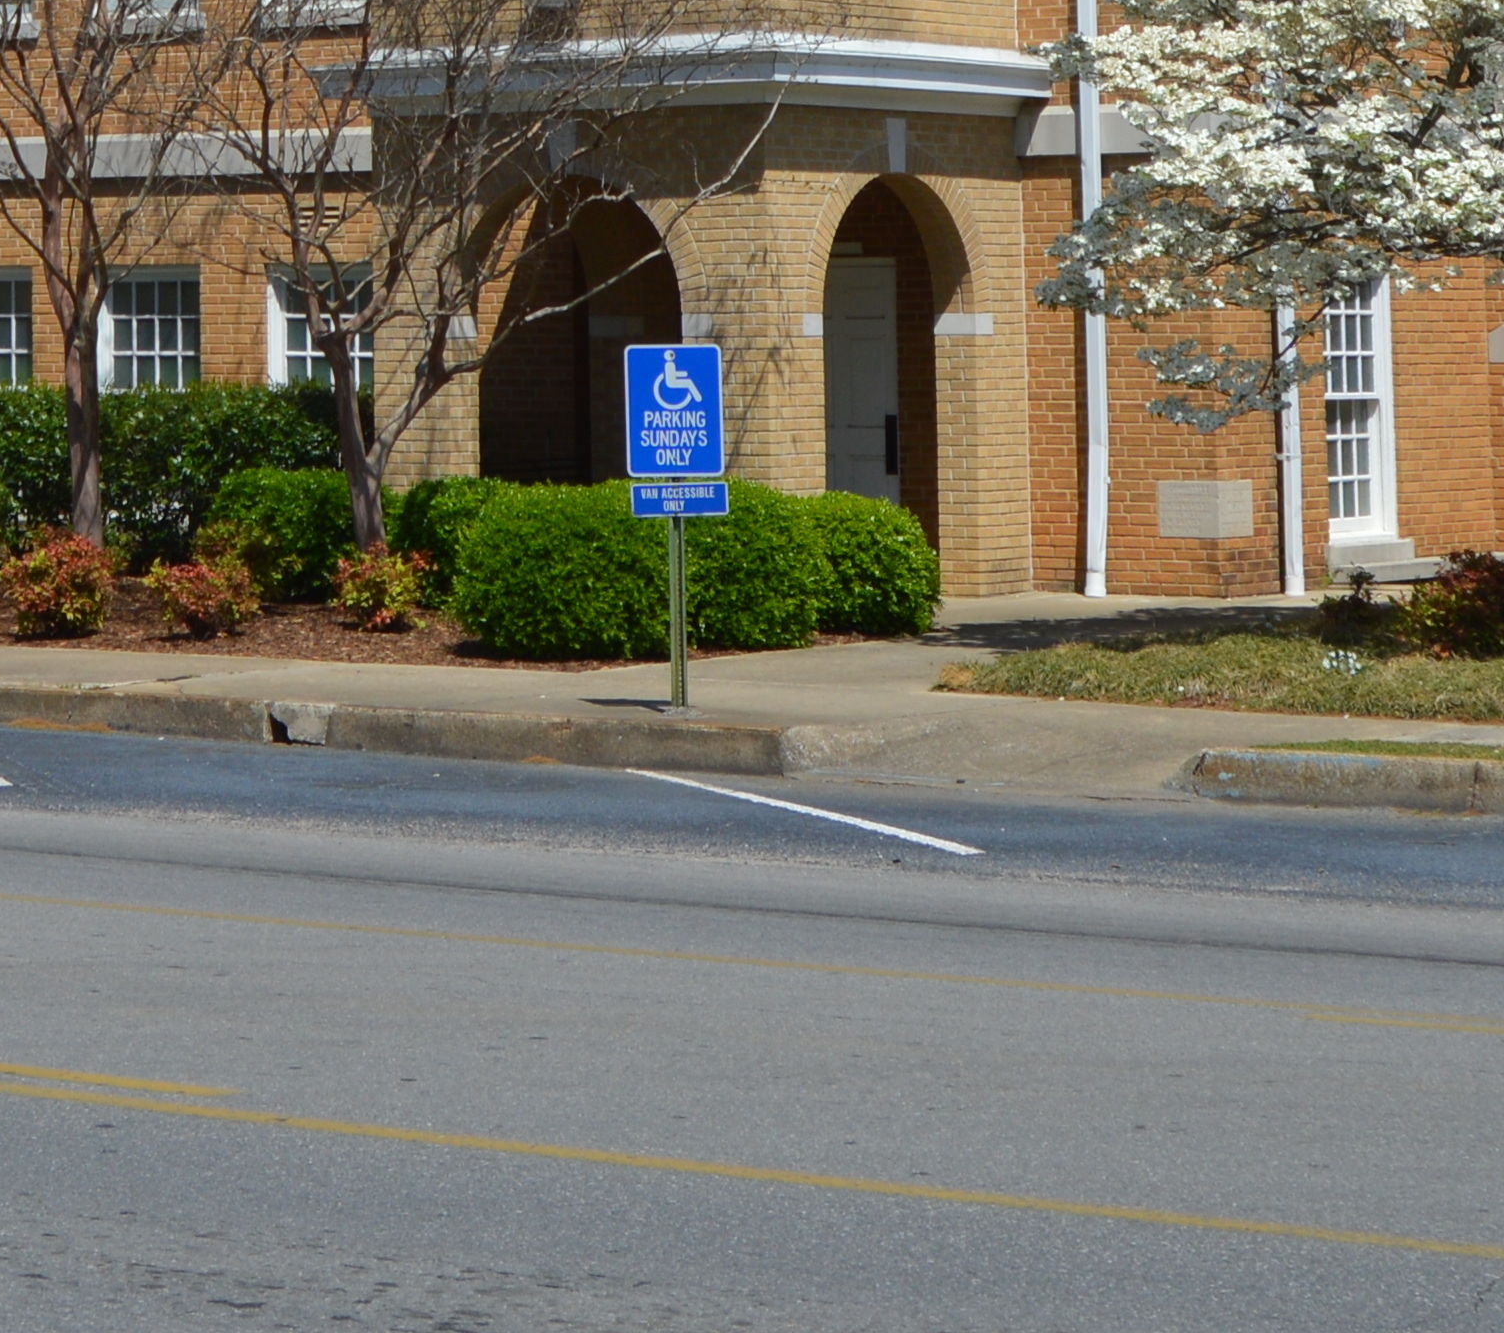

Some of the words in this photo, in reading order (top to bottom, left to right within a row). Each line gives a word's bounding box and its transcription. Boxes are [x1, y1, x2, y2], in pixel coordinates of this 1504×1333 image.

[644, 411, 706, 428] PARKING
[640, 430, 708, 447] SUNDAYS
[656, 449, 692, 466] ONLY
[641, 488, 658, 499] VAN
[662, 487, 715, 498] ACCESSIBLE
[663, 500, 685, 511] ONLY
